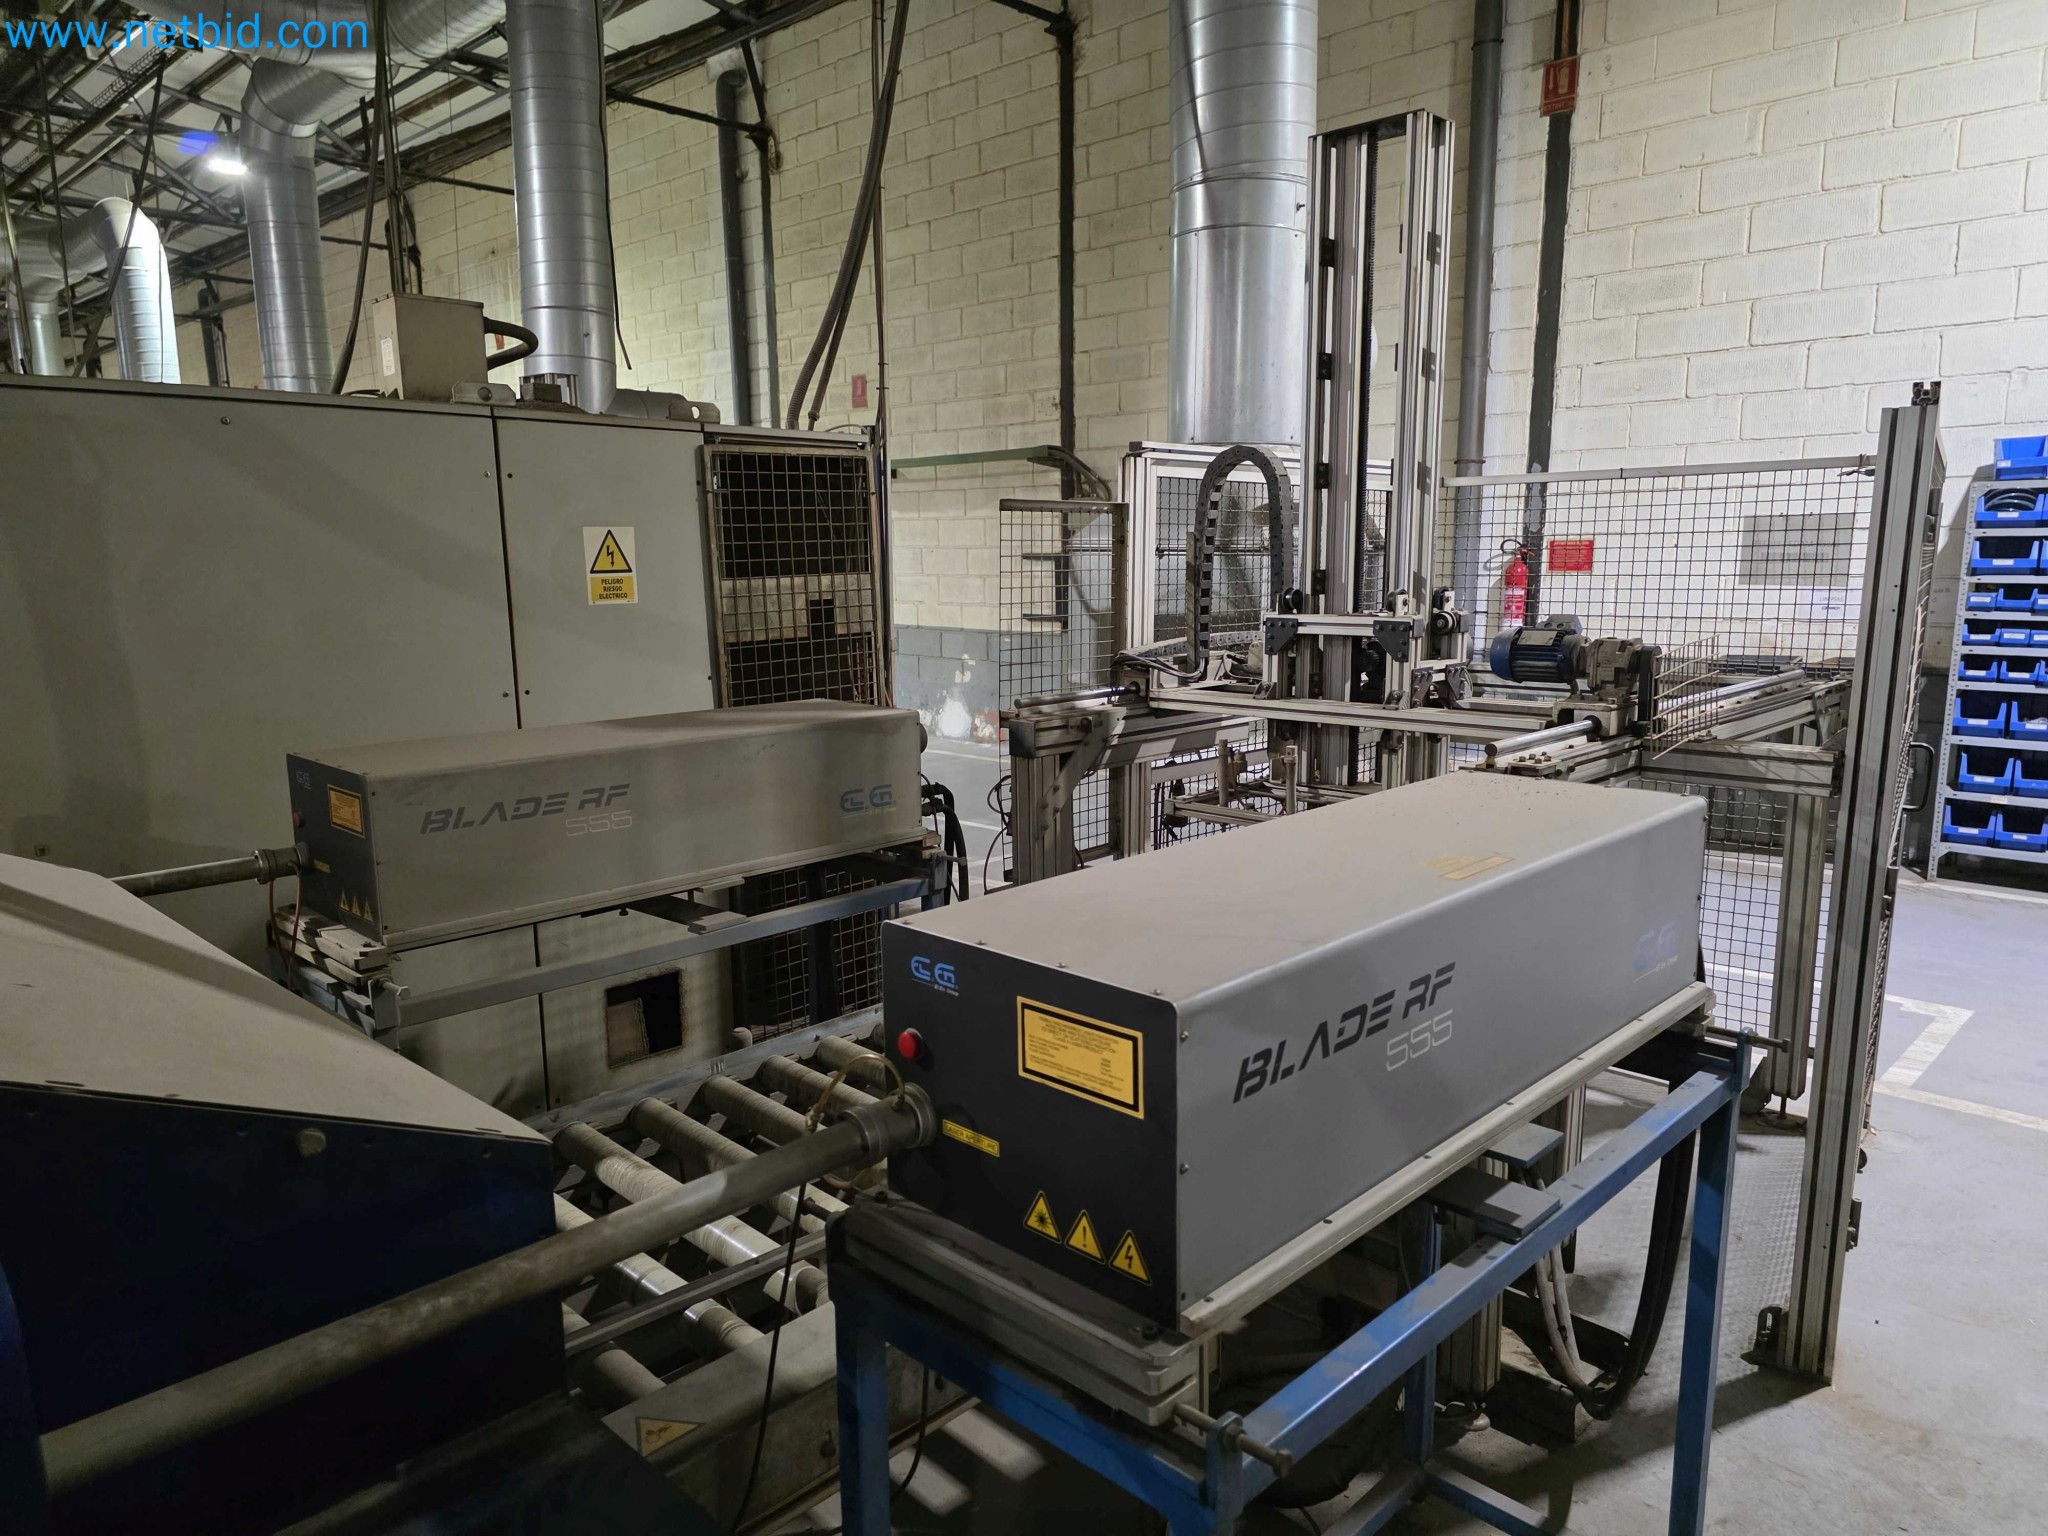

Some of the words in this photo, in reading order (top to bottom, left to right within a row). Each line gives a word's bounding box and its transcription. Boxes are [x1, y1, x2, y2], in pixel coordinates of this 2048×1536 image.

[419, 791, 570, 835] BLADE
[577, 783, 631, 811] RF
[565, 809, 633, 838] 555
[1232, 988, 1397, 1104] BLADE
[1402, 960, 1457, 1020] RF
[1385, 1008, 1454, 1072] 555
